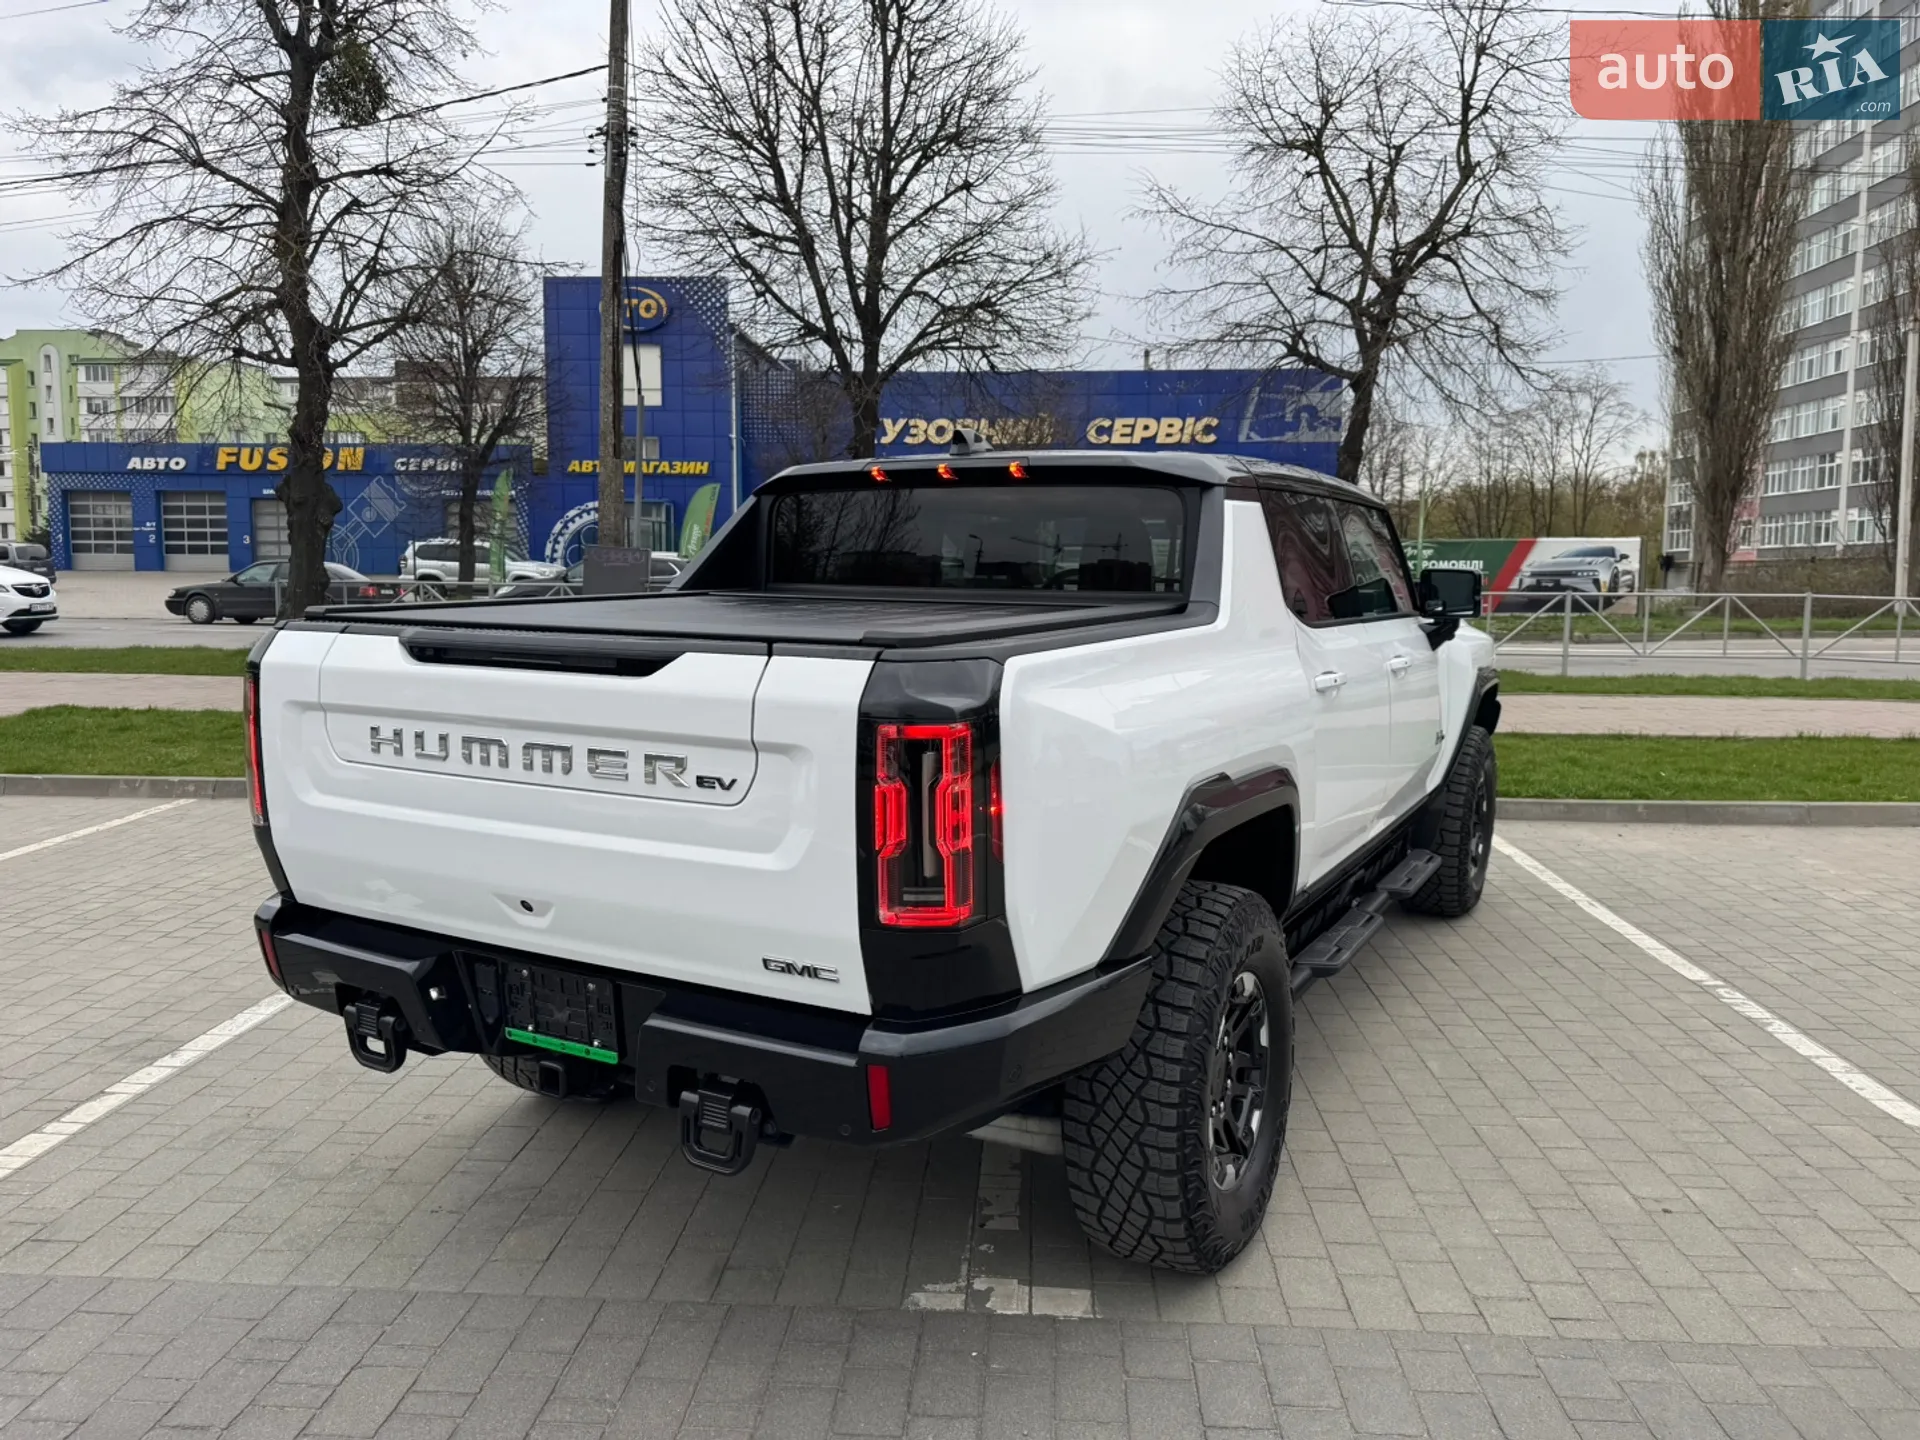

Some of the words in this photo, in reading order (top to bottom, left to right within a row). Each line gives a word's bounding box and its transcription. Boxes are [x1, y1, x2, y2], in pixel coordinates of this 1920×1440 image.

[1086, 417, 1219, 444] СЕРВІС
[126, 457, 187, 471] АВТО
[215, 447, 365, 471] FUSN
[566, 460, 710, 475] АВТМАГАЗИН
[148, 534, 156, 543] 2
[242, 535, 251, 544] 3
[369, 724, 690, 789] HUMMER
[695, 774, 739, 792] EV
[762, 954, 840, 983] GMC
